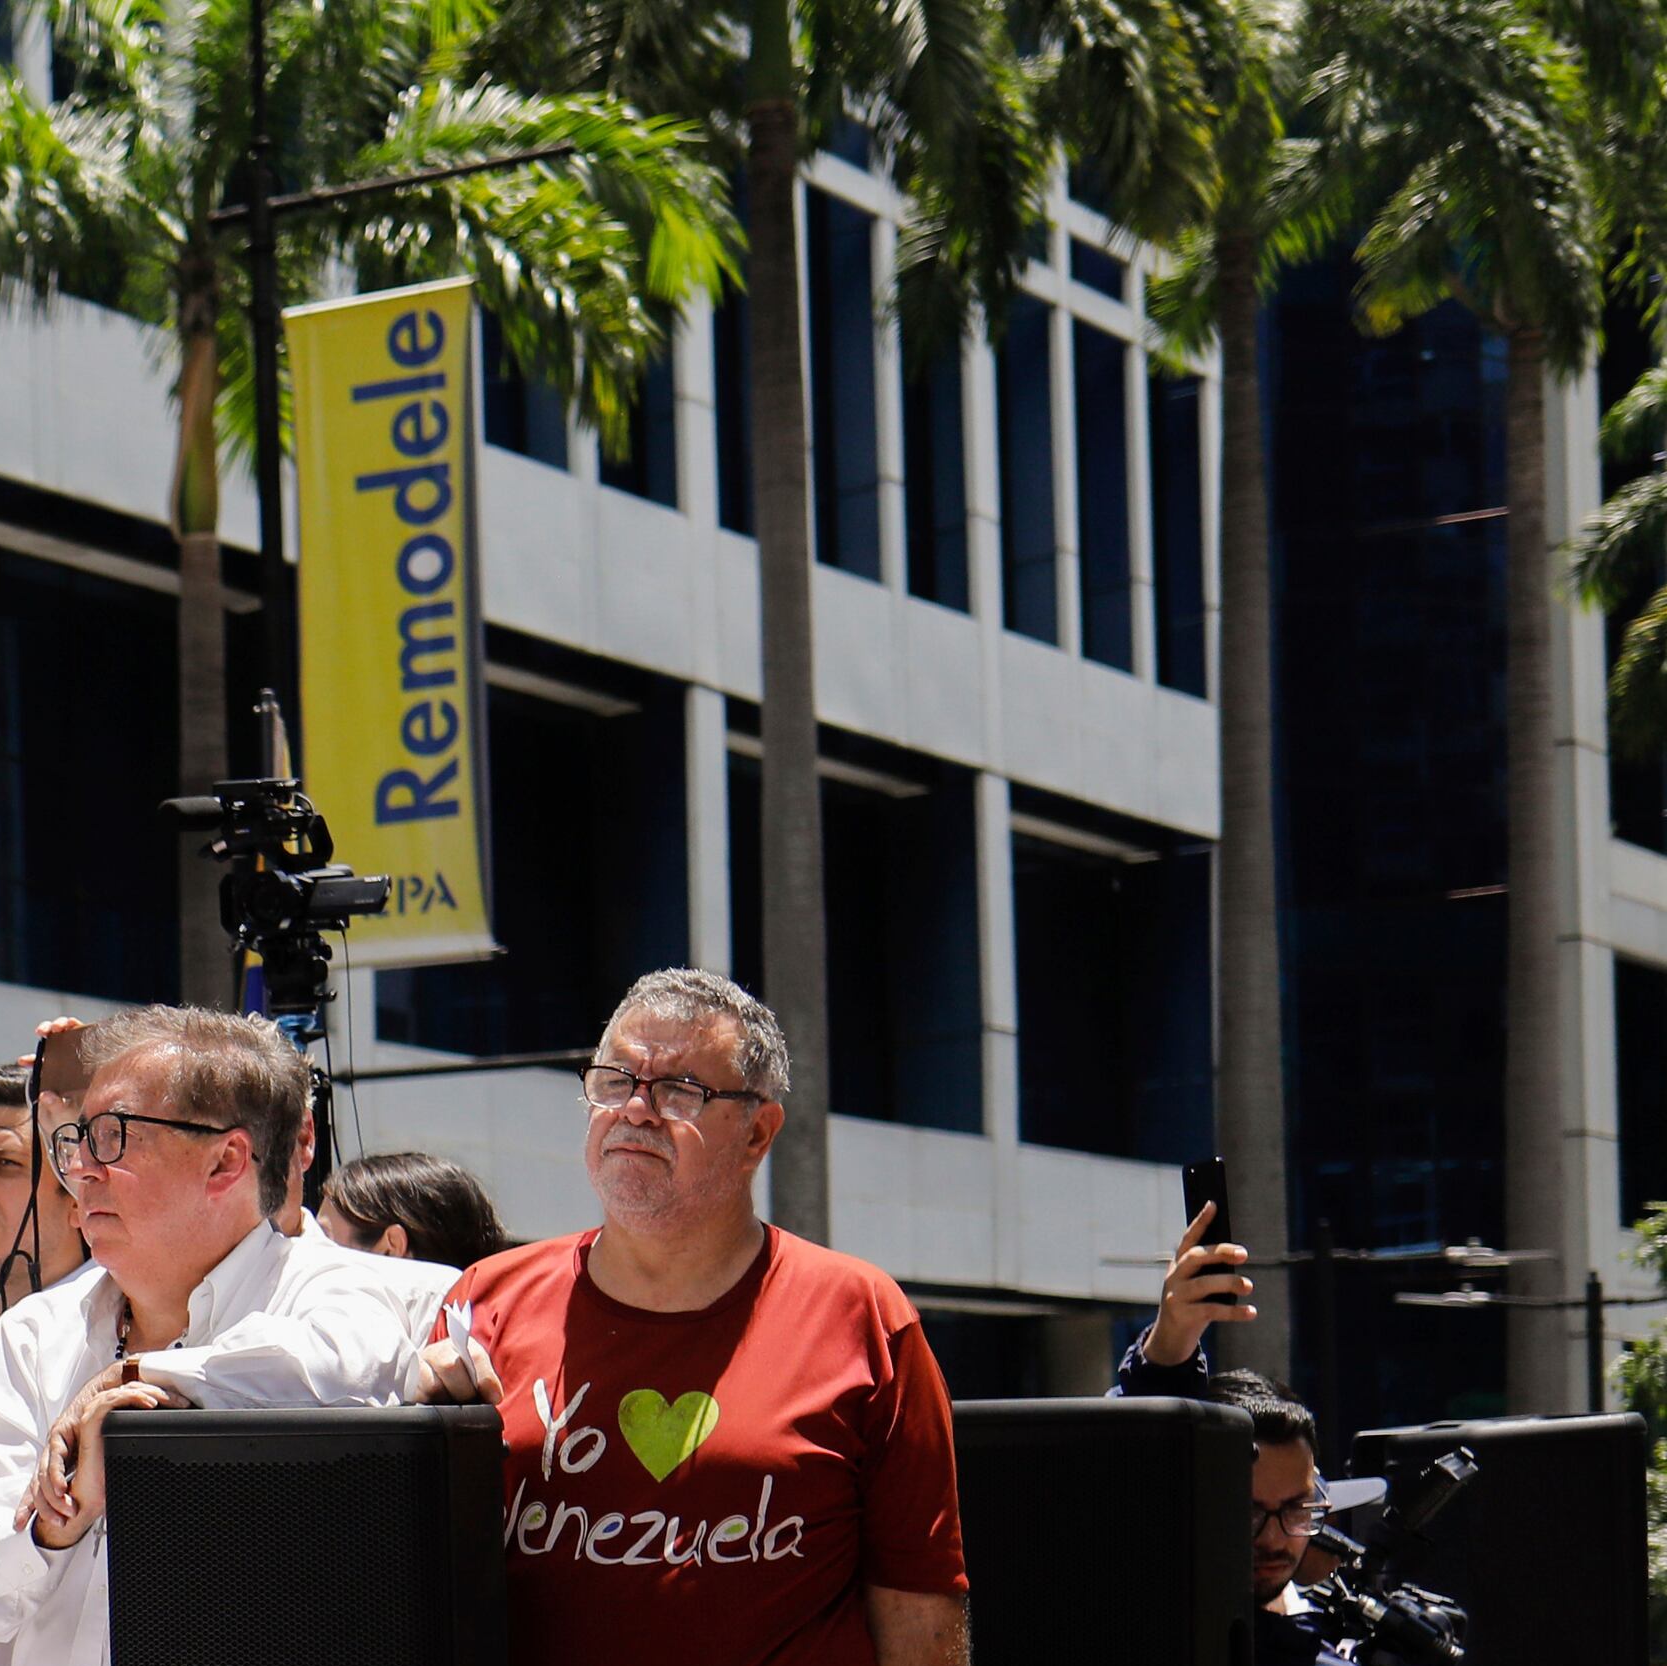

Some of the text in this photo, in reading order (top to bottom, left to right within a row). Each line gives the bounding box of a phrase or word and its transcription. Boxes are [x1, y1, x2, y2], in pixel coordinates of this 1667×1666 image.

[351, 310, 461, 825] Remodele
[363, 872, 458, 920] PA
[532, 1377, 607, 1482] Yo
